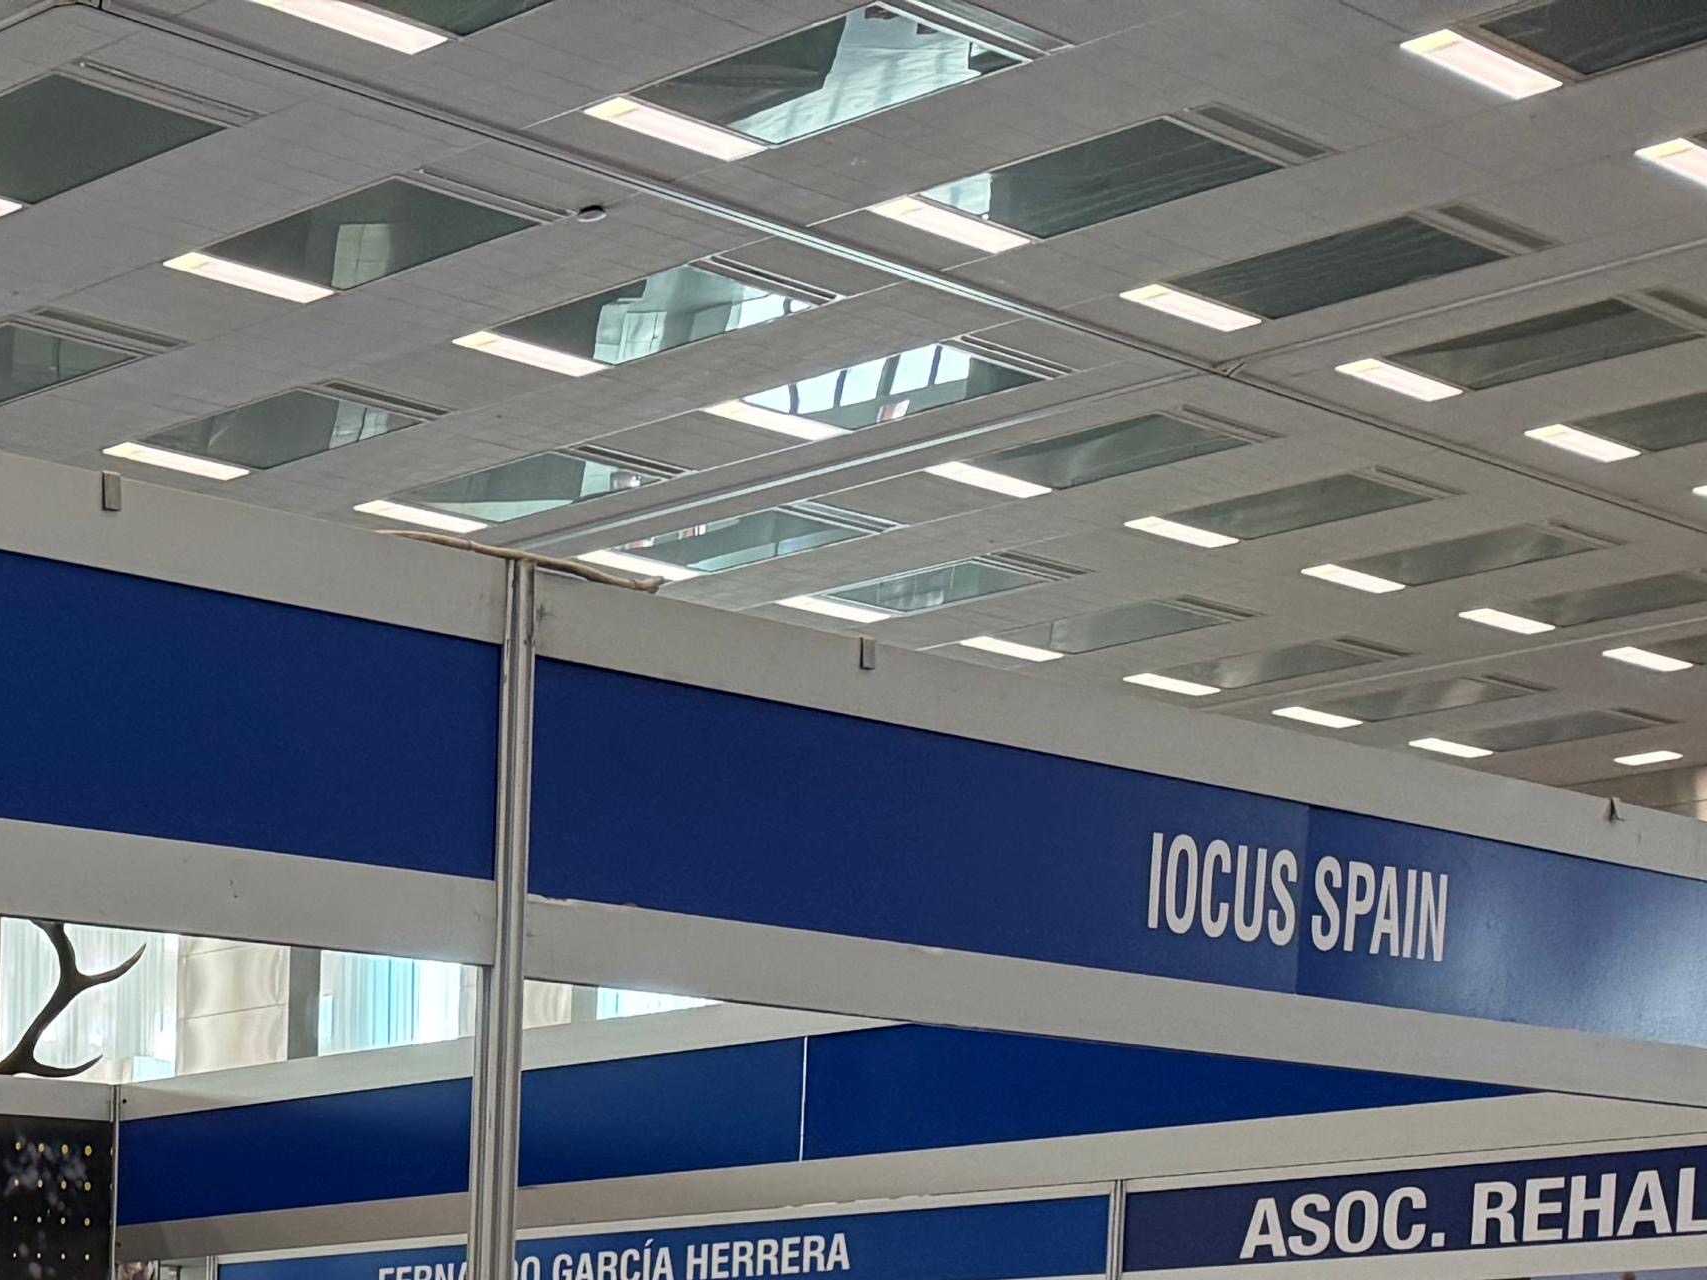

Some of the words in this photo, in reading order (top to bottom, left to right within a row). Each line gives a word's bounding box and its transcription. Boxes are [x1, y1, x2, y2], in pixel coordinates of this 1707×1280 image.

[1147, 831, 1298, 947] IOCUS
[1311, 855, 1449, 962] SPAIN
[1239, 1186, 1446, 1261] ASOC.
[1470, 1166, 1707, 1246] REHAL
